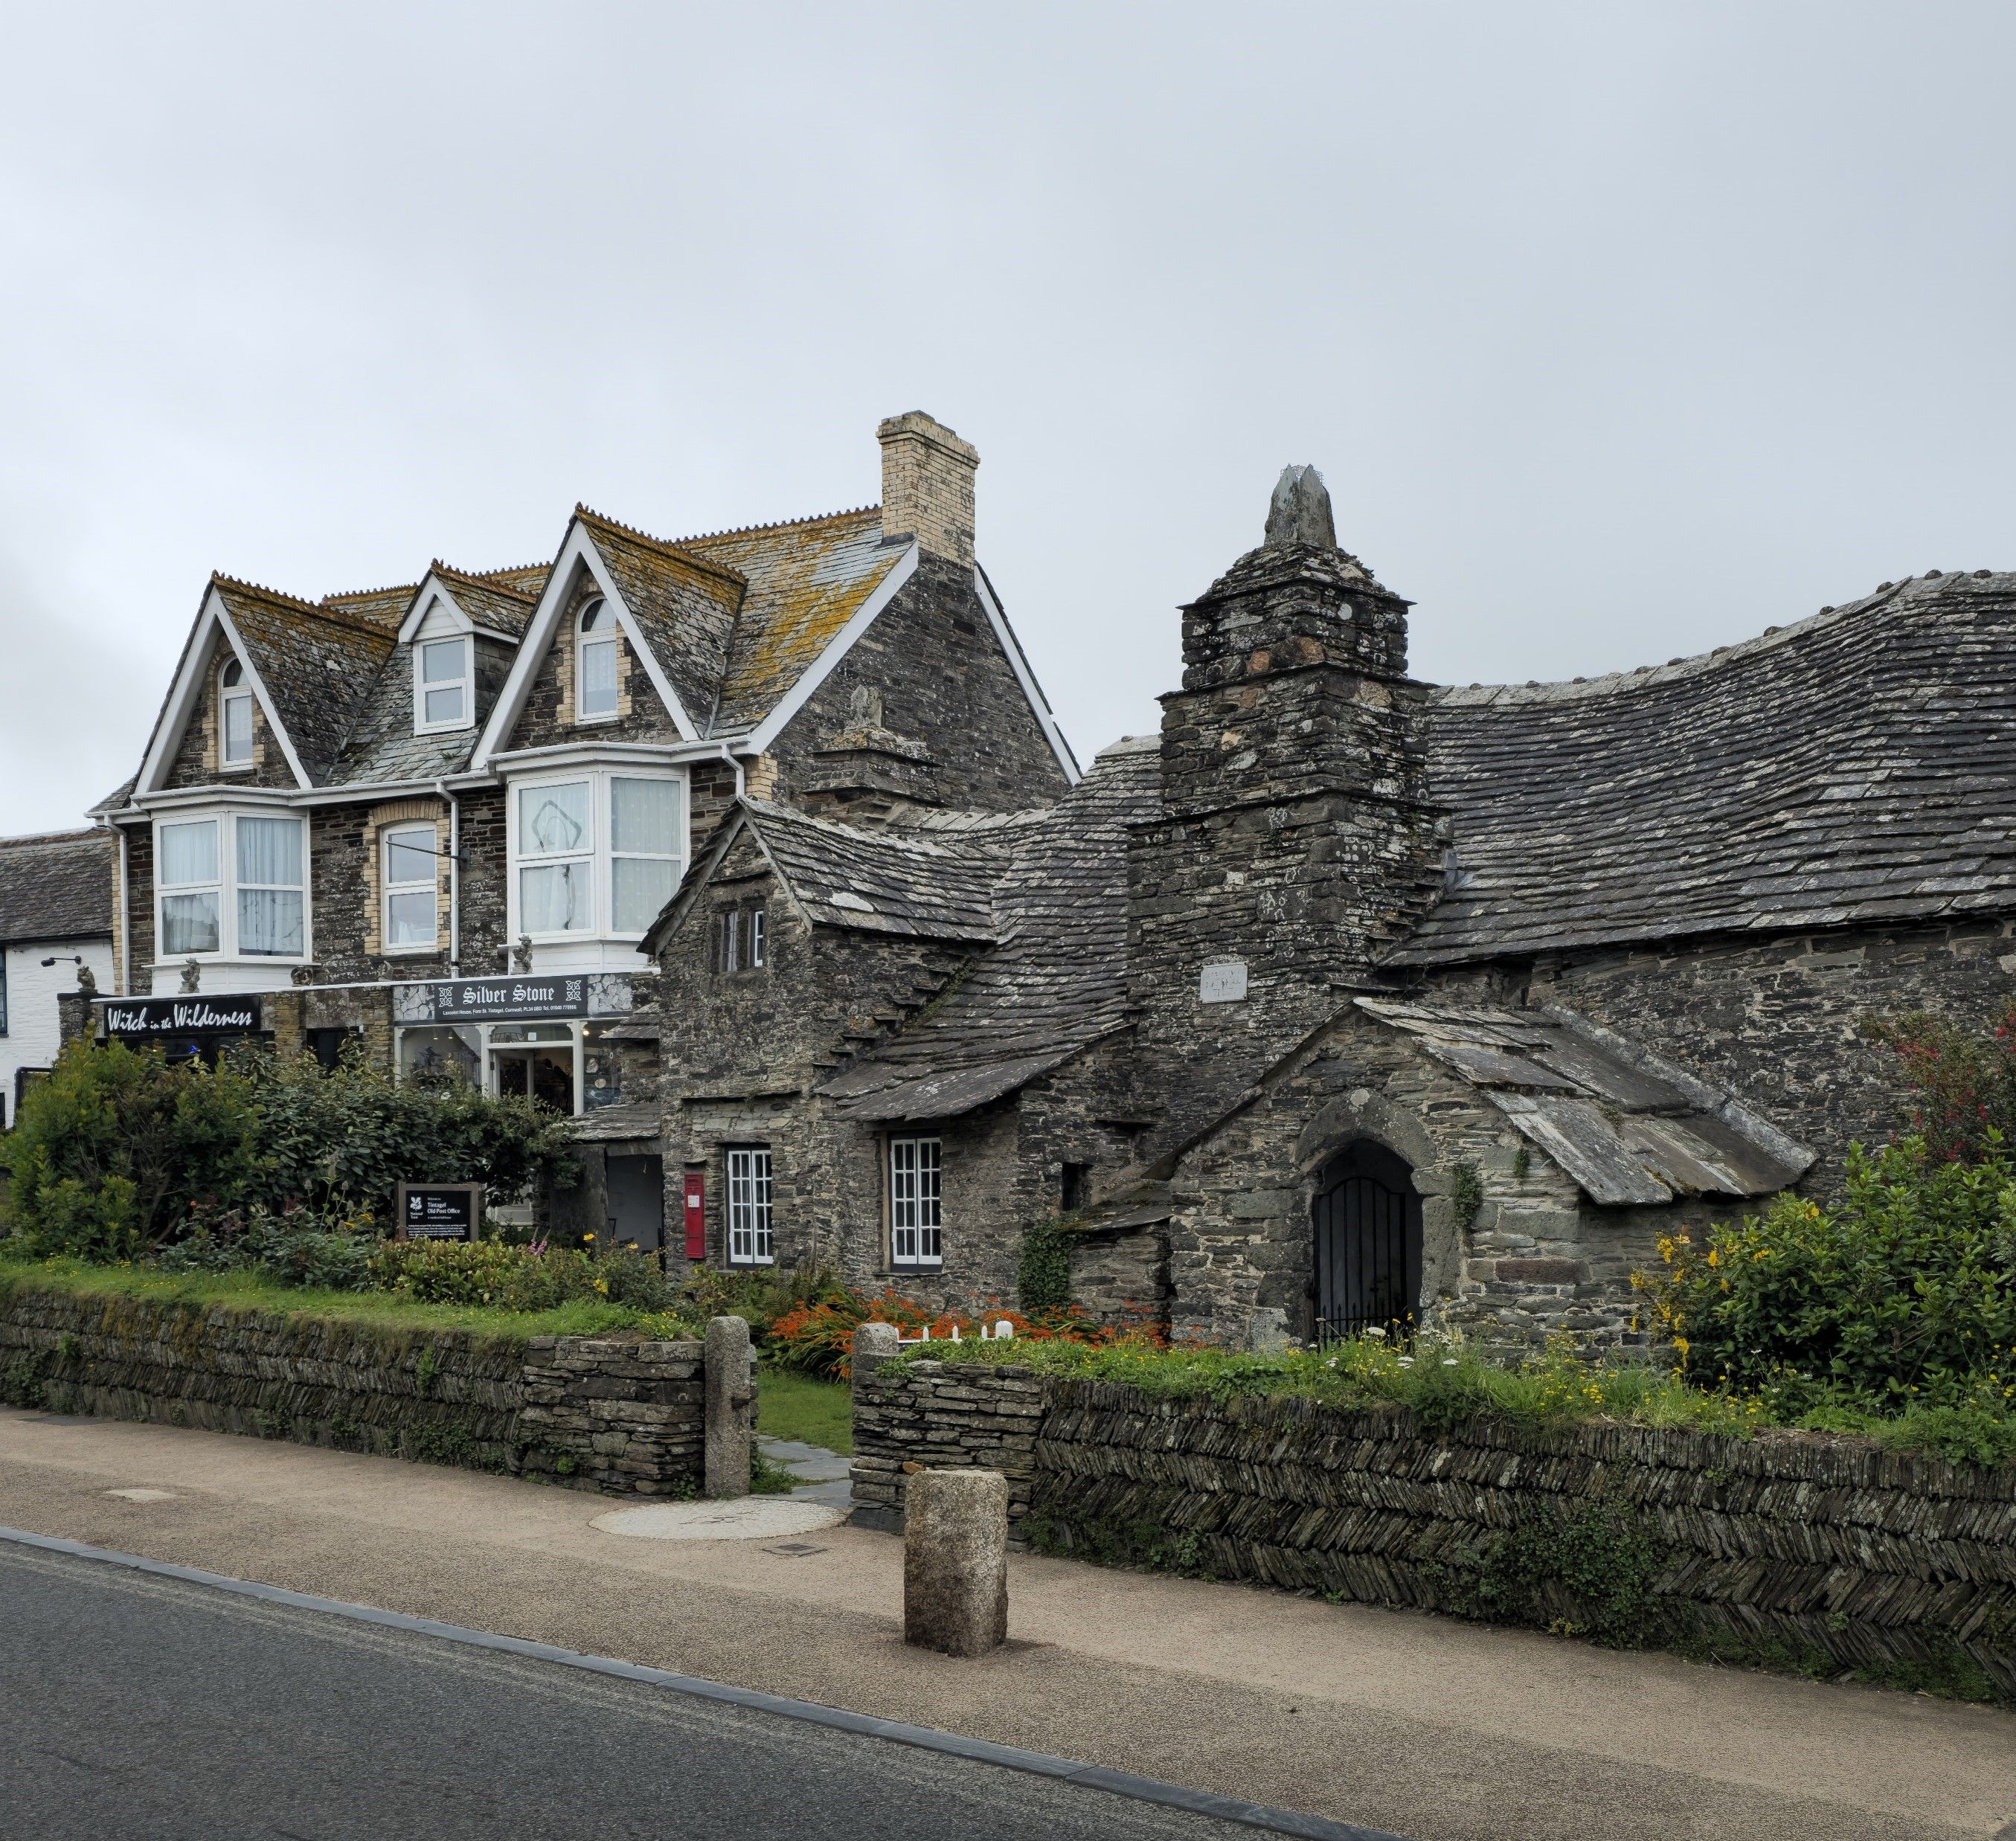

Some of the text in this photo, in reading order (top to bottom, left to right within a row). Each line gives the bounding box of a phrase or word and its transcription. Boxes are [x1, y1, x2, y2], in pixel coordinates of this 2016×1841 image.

[463, 984, 555, 1004] Silver Stone
[108, 1003, 252, 1031] Witch in the Wilderness
